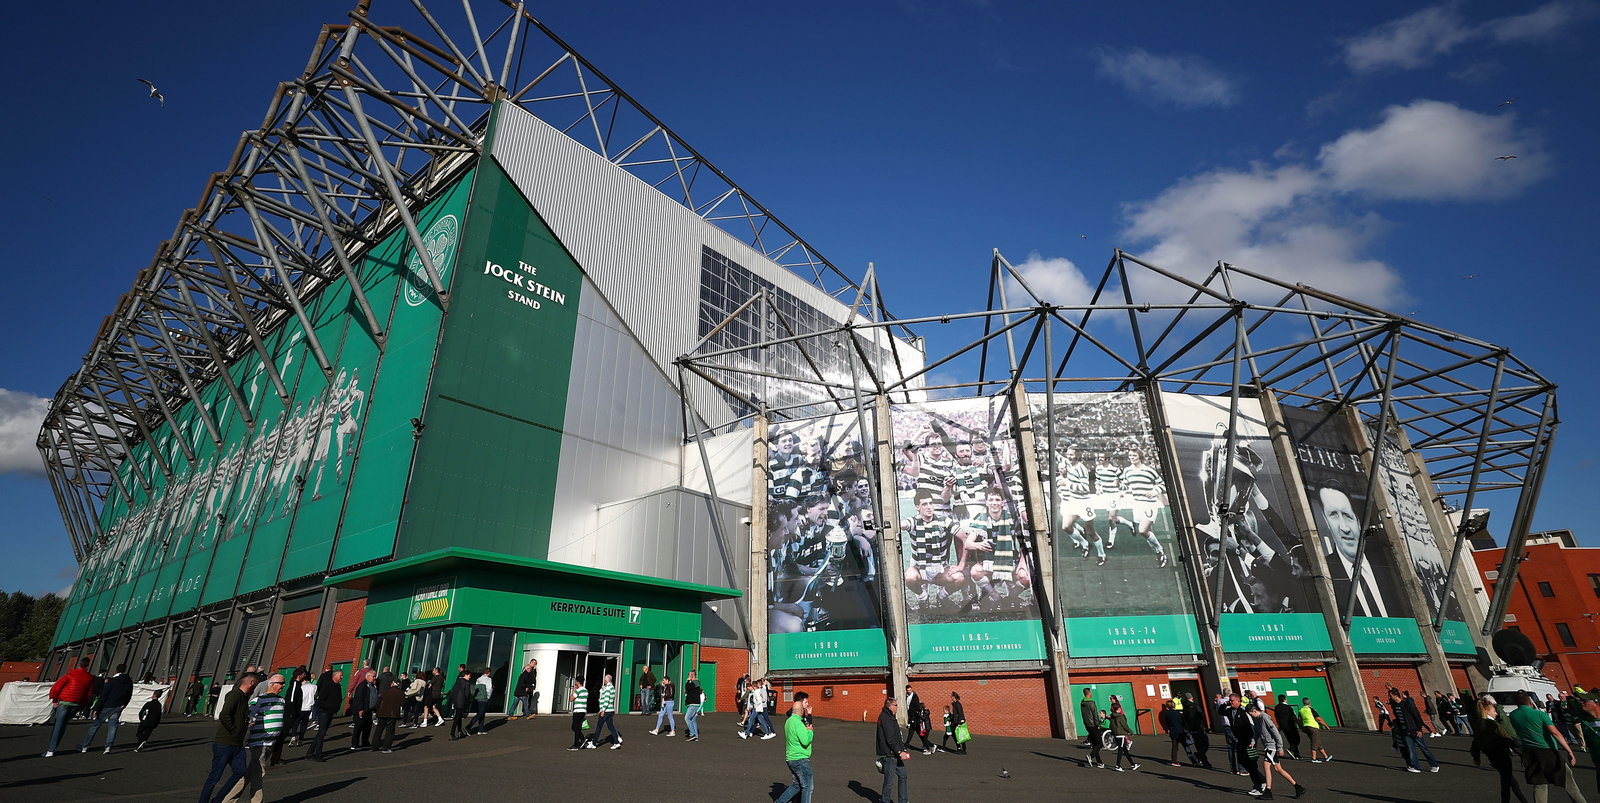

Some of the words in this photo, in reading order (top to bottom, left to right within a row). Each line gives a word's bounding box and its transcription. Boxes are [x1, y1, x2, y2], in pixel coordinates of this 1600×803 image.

[518, 260, 537, 276] THE
[484, 260, 523, 287] JOCK
[527, 279, 566, 305] STEIN
[508, 290, 541, 310] STAND
[1086, 507, 1093, 517] 8
[144, 587, 164, 605] ARE
[168, 575, 201, 598] MADE
[550, 601, 601, 616] KERRYDALE
[603, 607, 626, 618] SUITE
[631, 609, 640, 622] 7
[1108, 626, 1156, 636] 1965-74
[1261, 624, 1284, 632] 1967
[962, 633, 989, 641] 1985
